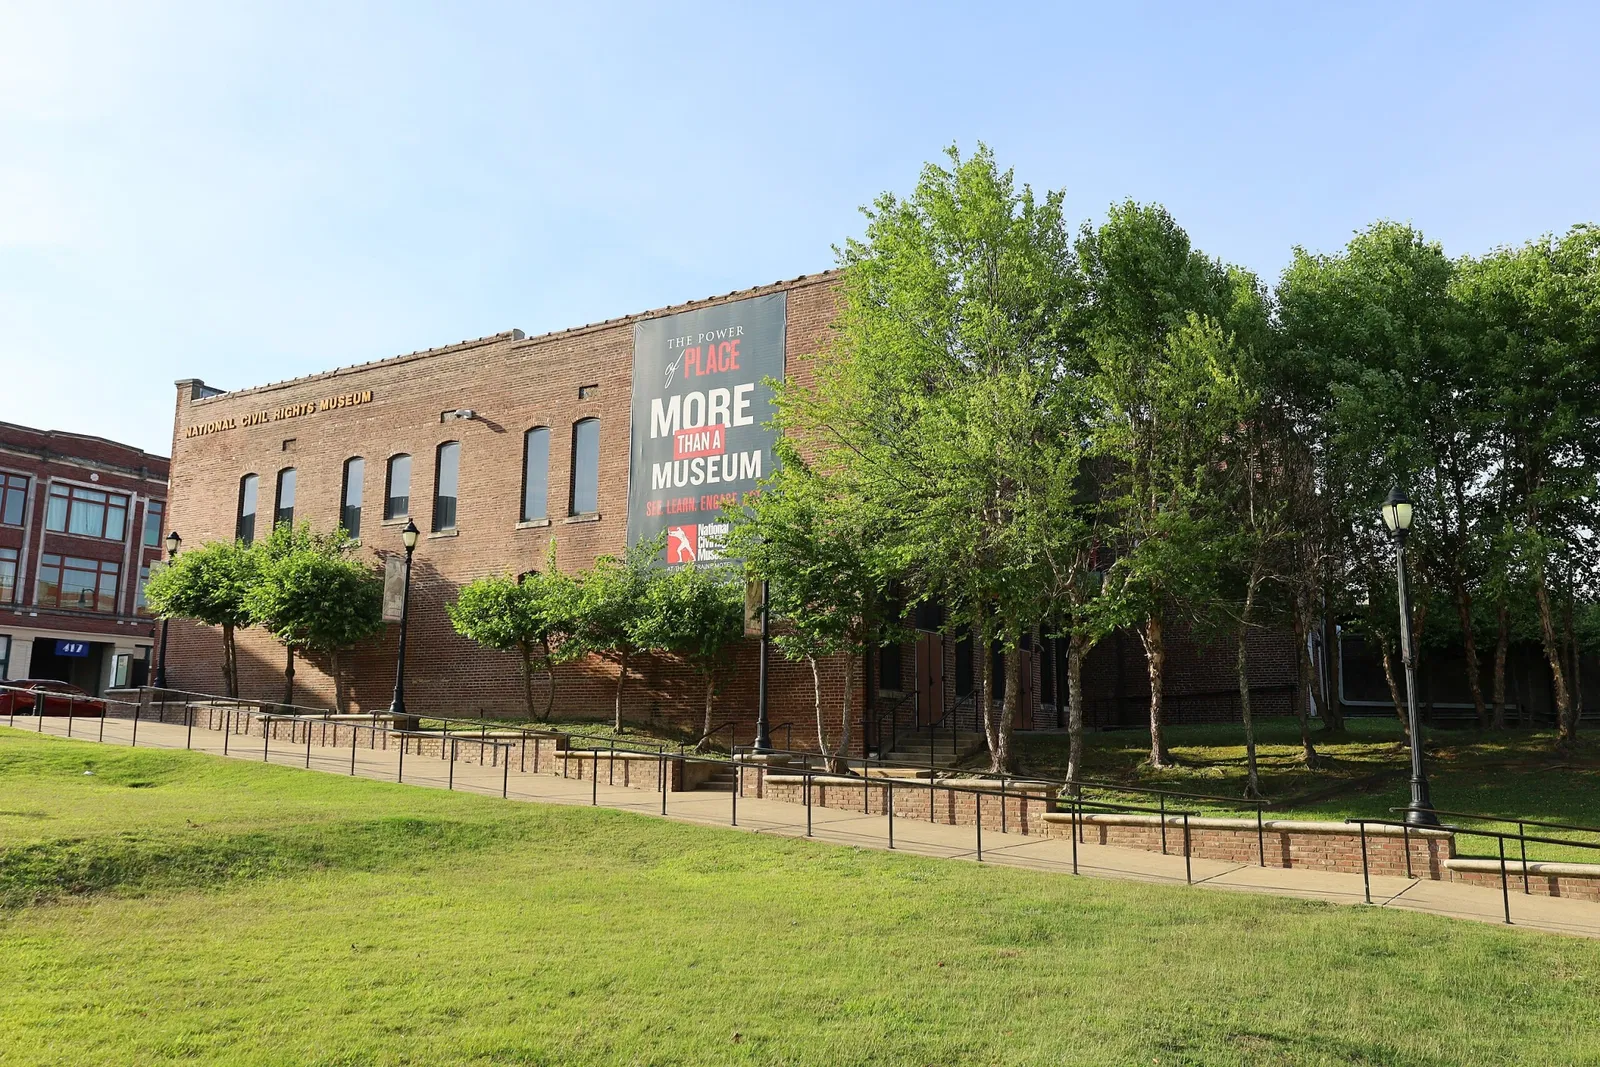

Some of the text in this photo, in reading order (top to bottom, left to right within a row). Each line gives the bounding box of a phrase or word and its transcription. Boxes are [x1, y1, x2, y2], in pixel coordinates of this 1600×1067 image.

[667, 326, 744, 349] THE POWER
[664, 339, 741, 389] of PLACE
[185, 390, 374, 438] NATIONAL CIVIL RIGHTS MUSEUM
[650, 382, 755, 439] MORE
[677, 430, 721, 454] THAN A
[651, 449, 762, 490] MUSEUM
[698, 522, 729, 536] National
[62, 643, 84, 653] 417
